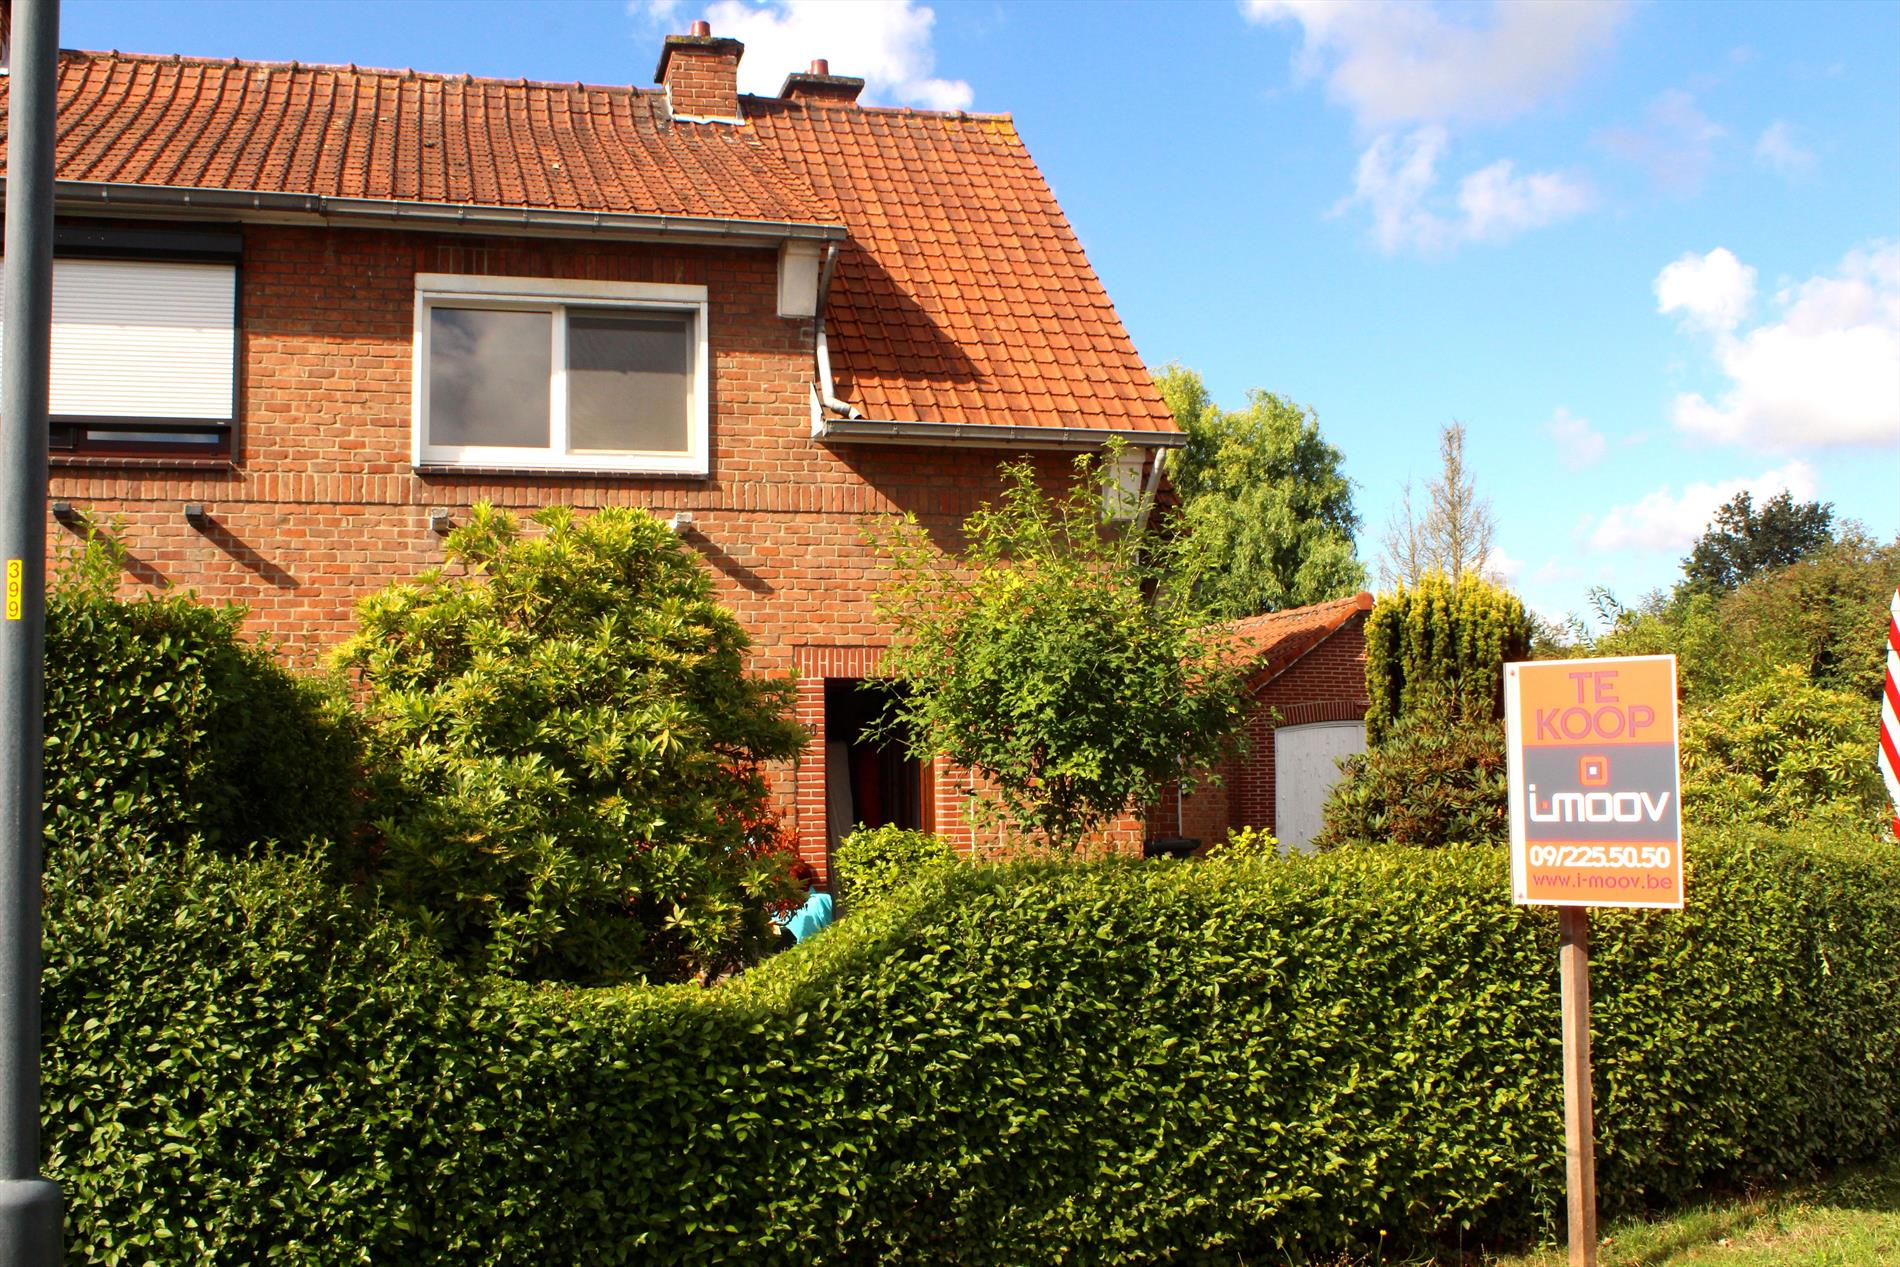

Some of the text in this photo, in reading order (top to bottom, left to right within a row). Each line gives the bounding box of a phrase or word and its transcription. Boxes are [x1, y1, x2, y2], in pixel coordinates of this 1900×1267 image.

[8, 562, 20, 617] 399
[1568, 670, 1620, 704] TE
[1536, 705, 1655, 740] KOOP
[1529, 845, 1671, 868] 09/225.50.50
[1532, 872, 1673, 890] www.i-moov.be
